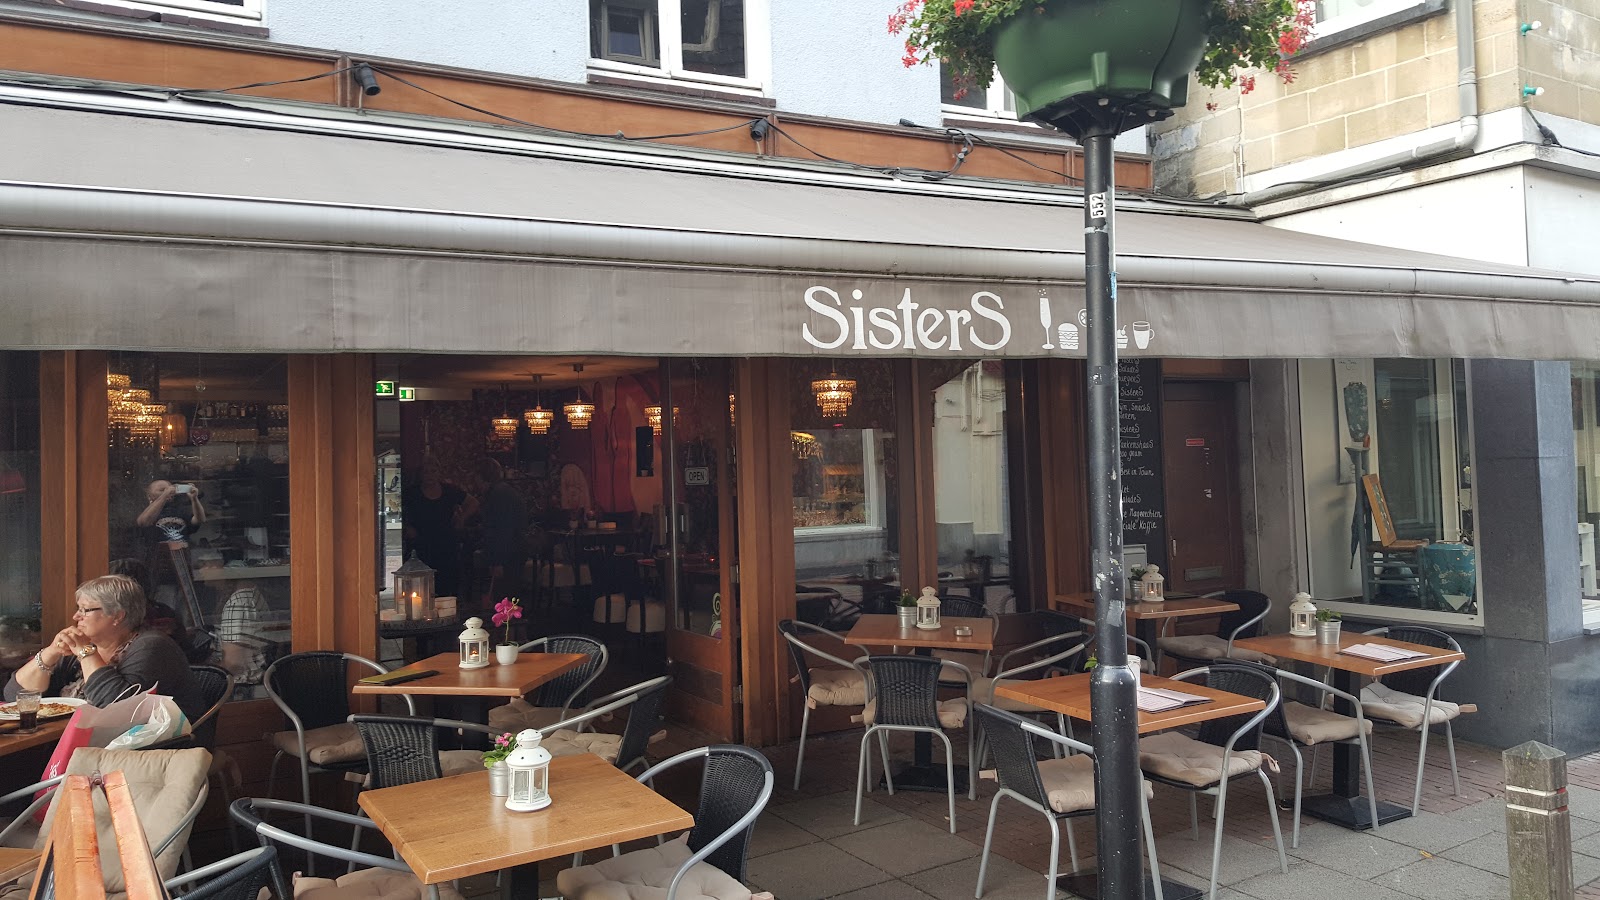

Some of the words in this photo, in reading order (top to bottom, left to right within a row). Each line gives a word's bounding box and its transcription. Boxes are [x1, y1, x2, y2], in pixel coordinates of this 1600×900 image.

[1091, 194, 1104, 217] 552
[802, 286, 1012, 351] SisterS
[688, 471, 705, 481] OPEN
